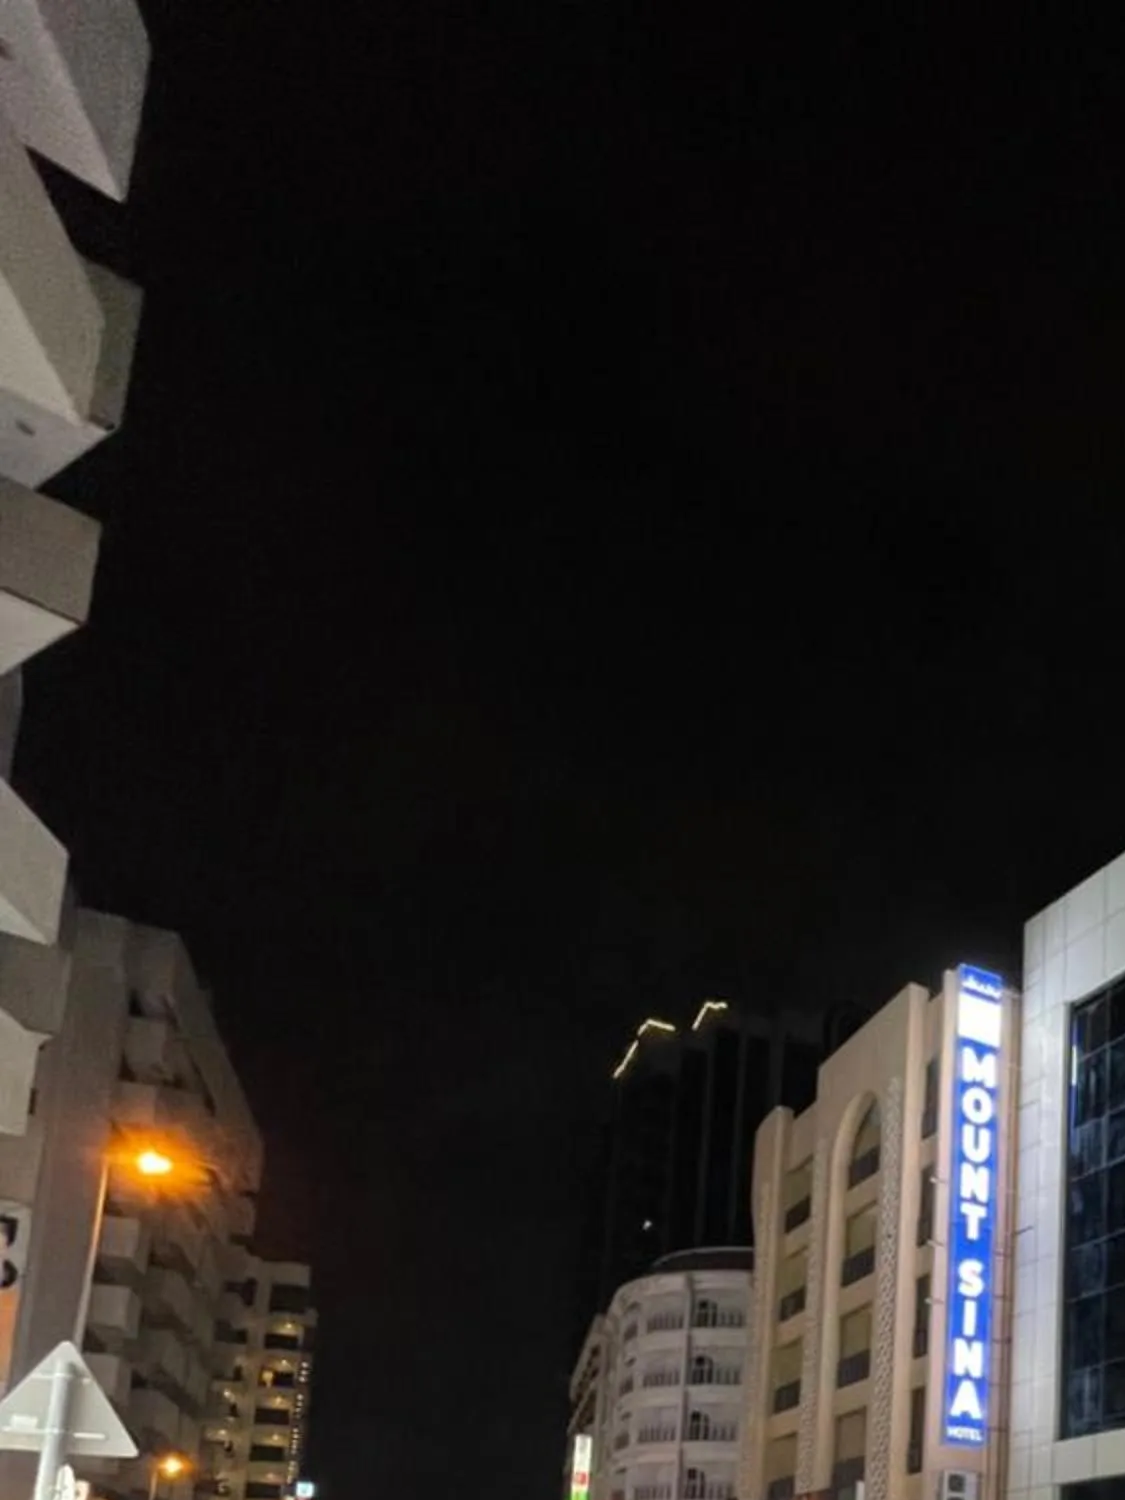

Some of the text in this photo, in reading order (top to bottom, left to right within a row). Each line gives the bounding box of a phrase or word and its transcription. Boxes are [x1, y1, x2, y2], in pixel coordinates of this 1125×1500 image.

[950, 1046, 997, 1419] MOUNT SINA
[947, 1426, 982, 1440] HOTEL
